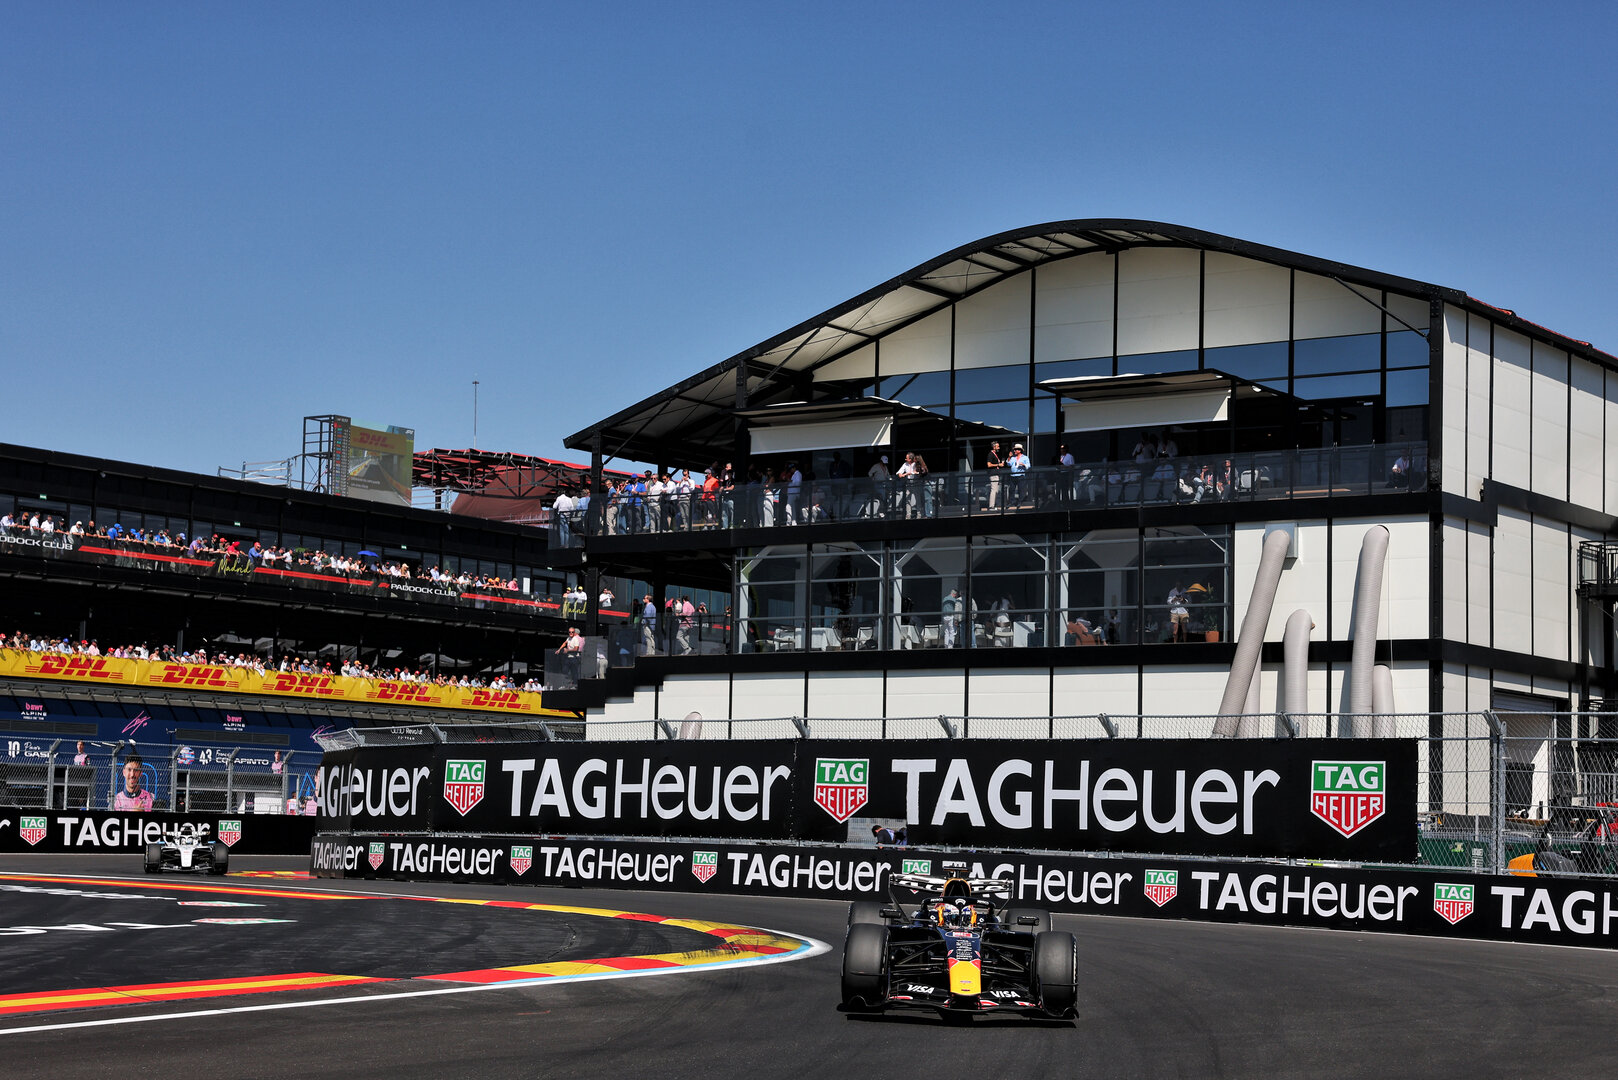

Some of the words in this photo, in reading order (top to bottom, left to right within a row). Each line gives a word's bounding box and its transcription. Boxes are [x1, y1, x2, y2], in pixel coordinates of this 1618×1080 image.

[42, 541, 73, 551] CLUB
[217, 559, 252, 576] Madrid
[391, 583, 434, 595] PADDOCK
[434, 588, 457, 597] CLUB
[39, 655, 111, 679] DHL
[162, 665, 227, 687] DHL
[275, 674, 334, 695] DHL
[377, 683, 431, 702] DHL
[472, 690, 522, 709] DHL
[450, 764, 482, 780] TAG
[821, 763, 864, 782] TAG
[1318, 766, 1379, 789] TAG
[446, 785, 482, 811] HEUER
[817, 788, 865, 818] HEUER
[1315, 795, 1381, 832] HEUER
[23, 819, 45, 828] TAG
[220, 822, 240, 831] TAG
[21, 829, 46, 843] HEUER
[219, 832, 241, 846] HEUER
[371, 845, 384, 853] TAG
[513, 848, 531, 857] TAG
[695, 853, 716, 864] TAG
[693, 865, 717, 880] HEUER
[904, 861, 929, 873] TAG
[1148, 872, 1175, 884] TAG
[1146, 886, 1176, 903] HEUER
[1437, 886, 1471, 899] TAG
[1436, 901, 1472, 921] HEUER
[907, 984, 935, 994] VISA
[990, 990, 1021, 998] VISA
